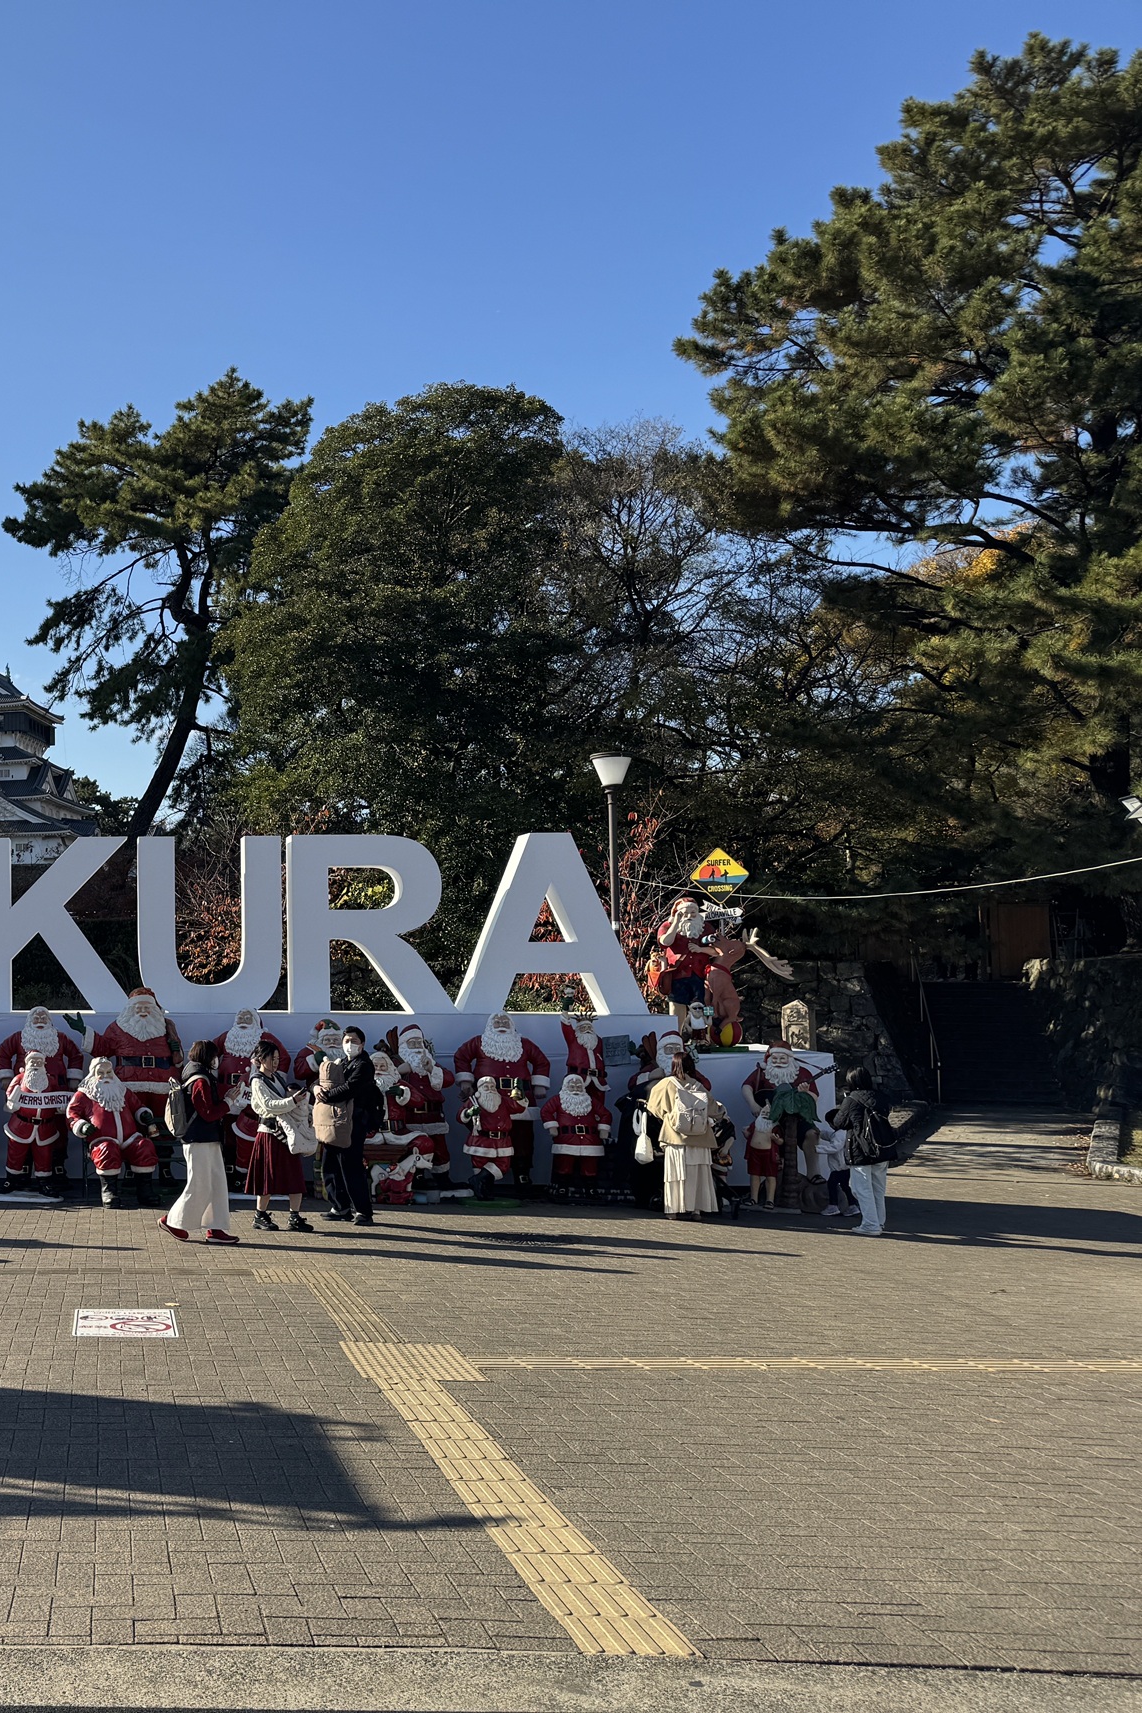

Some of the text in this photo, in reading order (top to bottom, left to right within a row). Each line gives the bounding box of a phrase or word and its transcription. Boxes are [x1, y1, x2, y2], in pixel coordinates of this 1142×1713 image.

[706, 858, 731, 866] SURFER
[707, 884, 733, 892] CROSSING
[18, 1093, 72, 1105] MERRY CHRISTM
